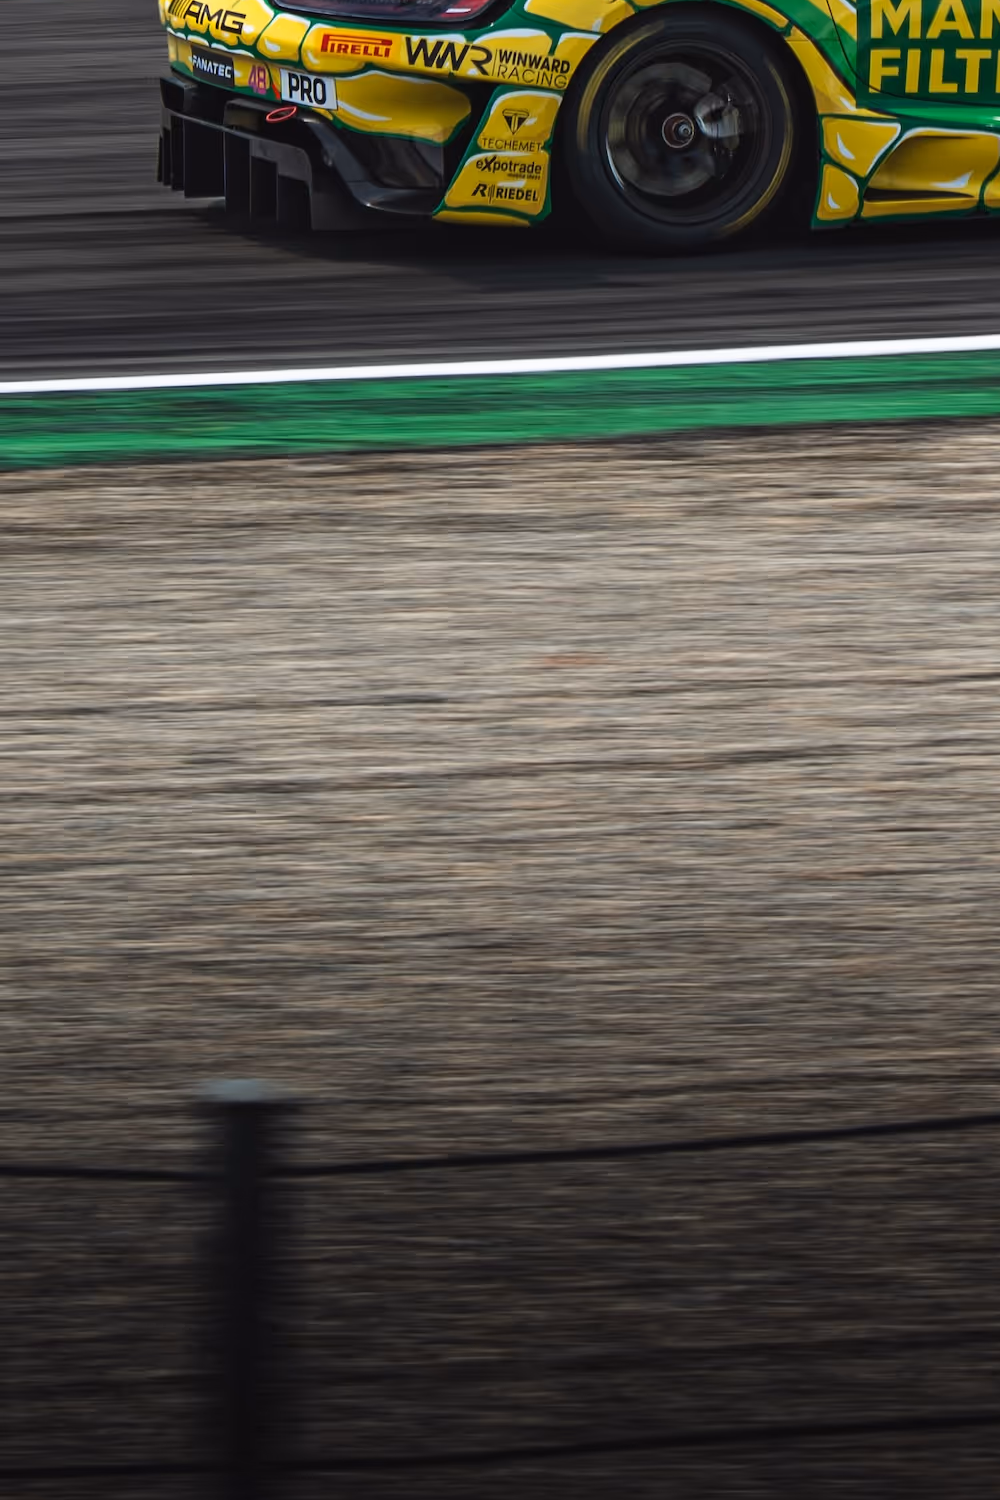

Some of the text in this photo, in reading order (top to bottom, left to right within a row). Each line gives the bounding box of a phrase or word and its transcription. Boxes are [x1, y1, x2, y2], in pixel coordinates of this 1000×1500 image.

[182, 0, 247, 36] AMG
[320, 34, 393, 58] PIRELLI
[192, 55, 233, 79] FANATEC
[498, 49, 571, 74] WINWARD
[248, 64, 267, 96] 48
[288, 72, 327, 105] PRO
[497, 65, 568, 89] RACING
[482, 137, 543, 152] TECHEMET
[496, 187, 540, 202] RIEDEL
